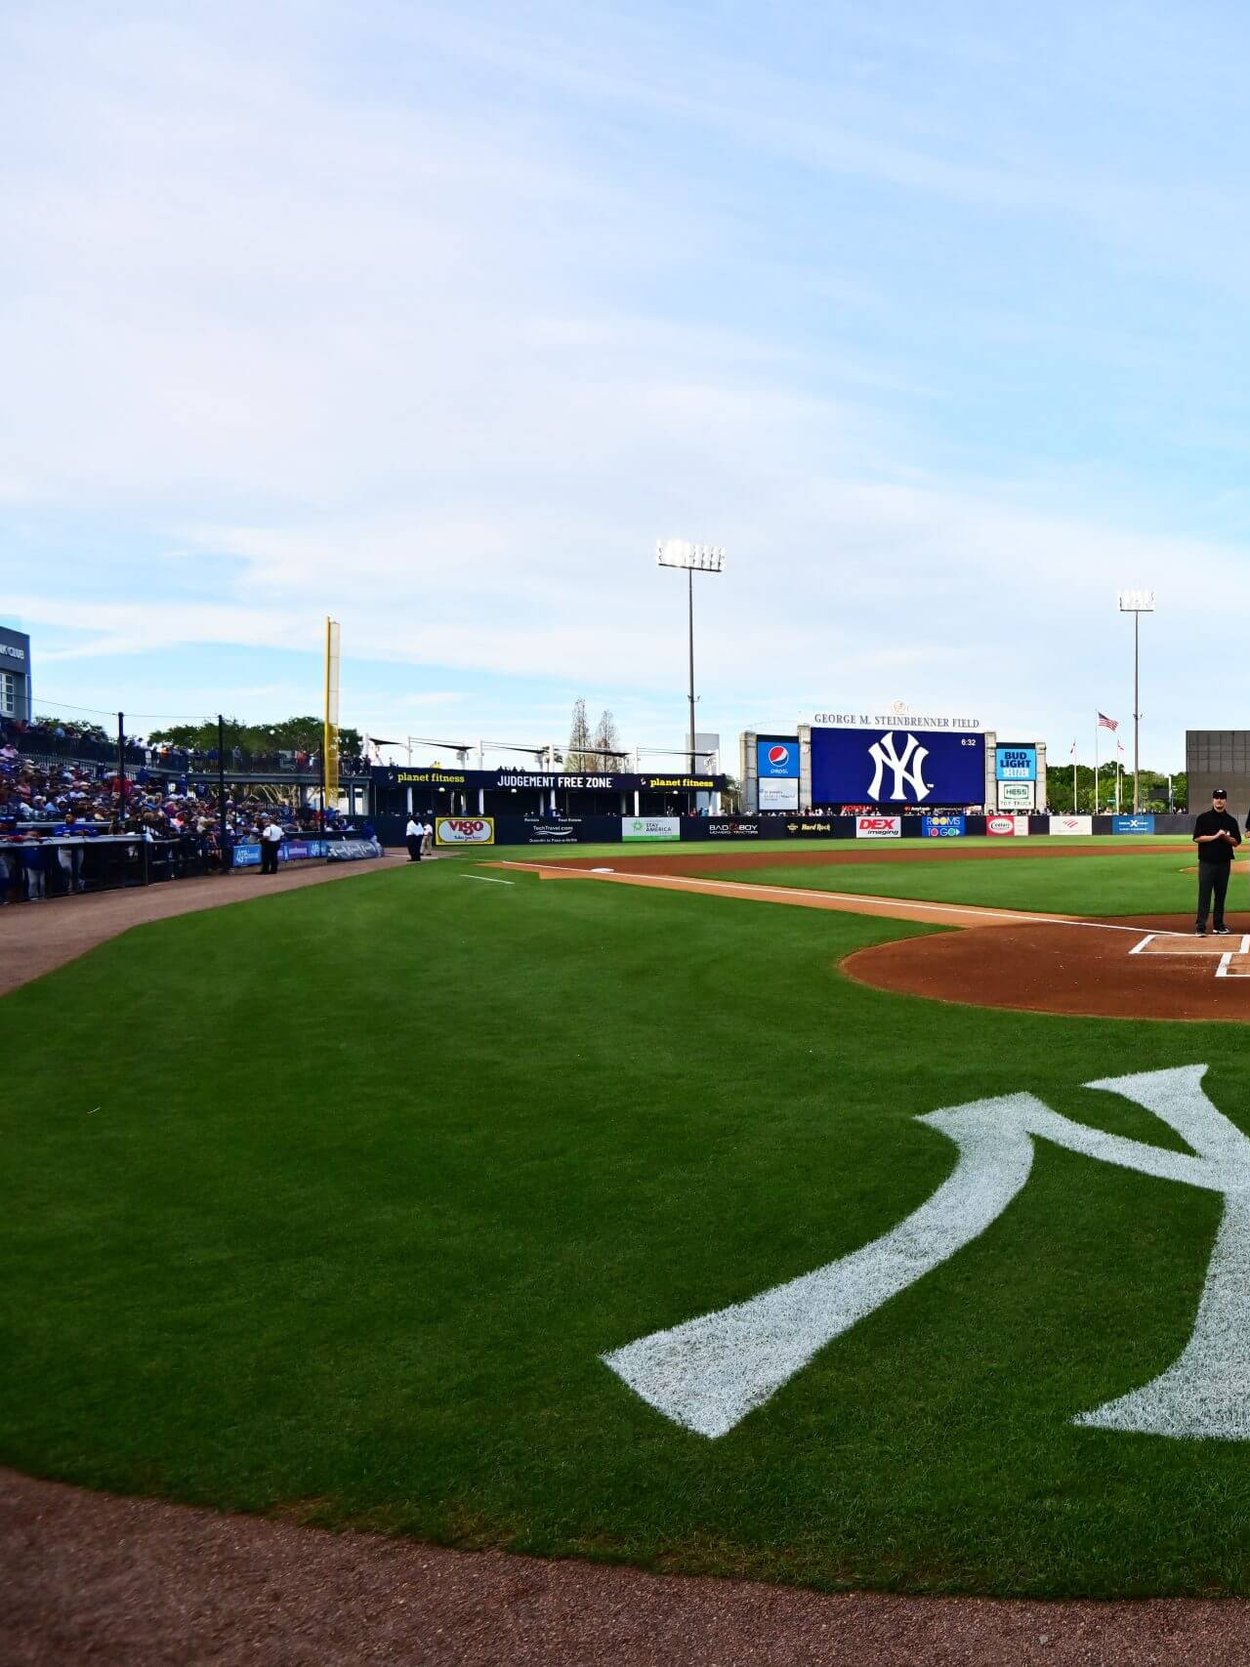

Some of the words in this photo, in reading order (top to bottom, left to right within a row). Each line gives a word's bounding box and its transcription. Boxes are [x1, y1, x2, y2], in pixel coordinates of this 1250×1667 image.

[814, 713, 856, 724] GEORGE
[859, 715, 871, 724] M.
[875, 716, 949, 727] STEINBRENNER
[952, 718, 979, 728] FIELD
[961, 738, 976, 746] 6:32
[1004, 751, 1027, 759] BUD
[867, 731, 930, 802] NY
[1000, 759, 1031, 768] LIGHT
[397, 772, 429, 783] planet
[431, 773, 465, 783] fitness
[497, 775, 555, 787] JUDGEMENT
[558, 776, 583, 788] FREE
[586, 777, 613, 788] ZONE
[650, 778, 680, 788] planet
[682, 779, 714, 787] fitness
[1006, 788, 1026, 796] HESS
[859, 819, 896, 830] DEX
[926, 817, 960, 825] ROOMS
[801, 823, 815, 831] Hard
[816, 823, 831, 832] Rock
[927, 827, 939, 837] TO
[940, 827, 956, 837] GO
